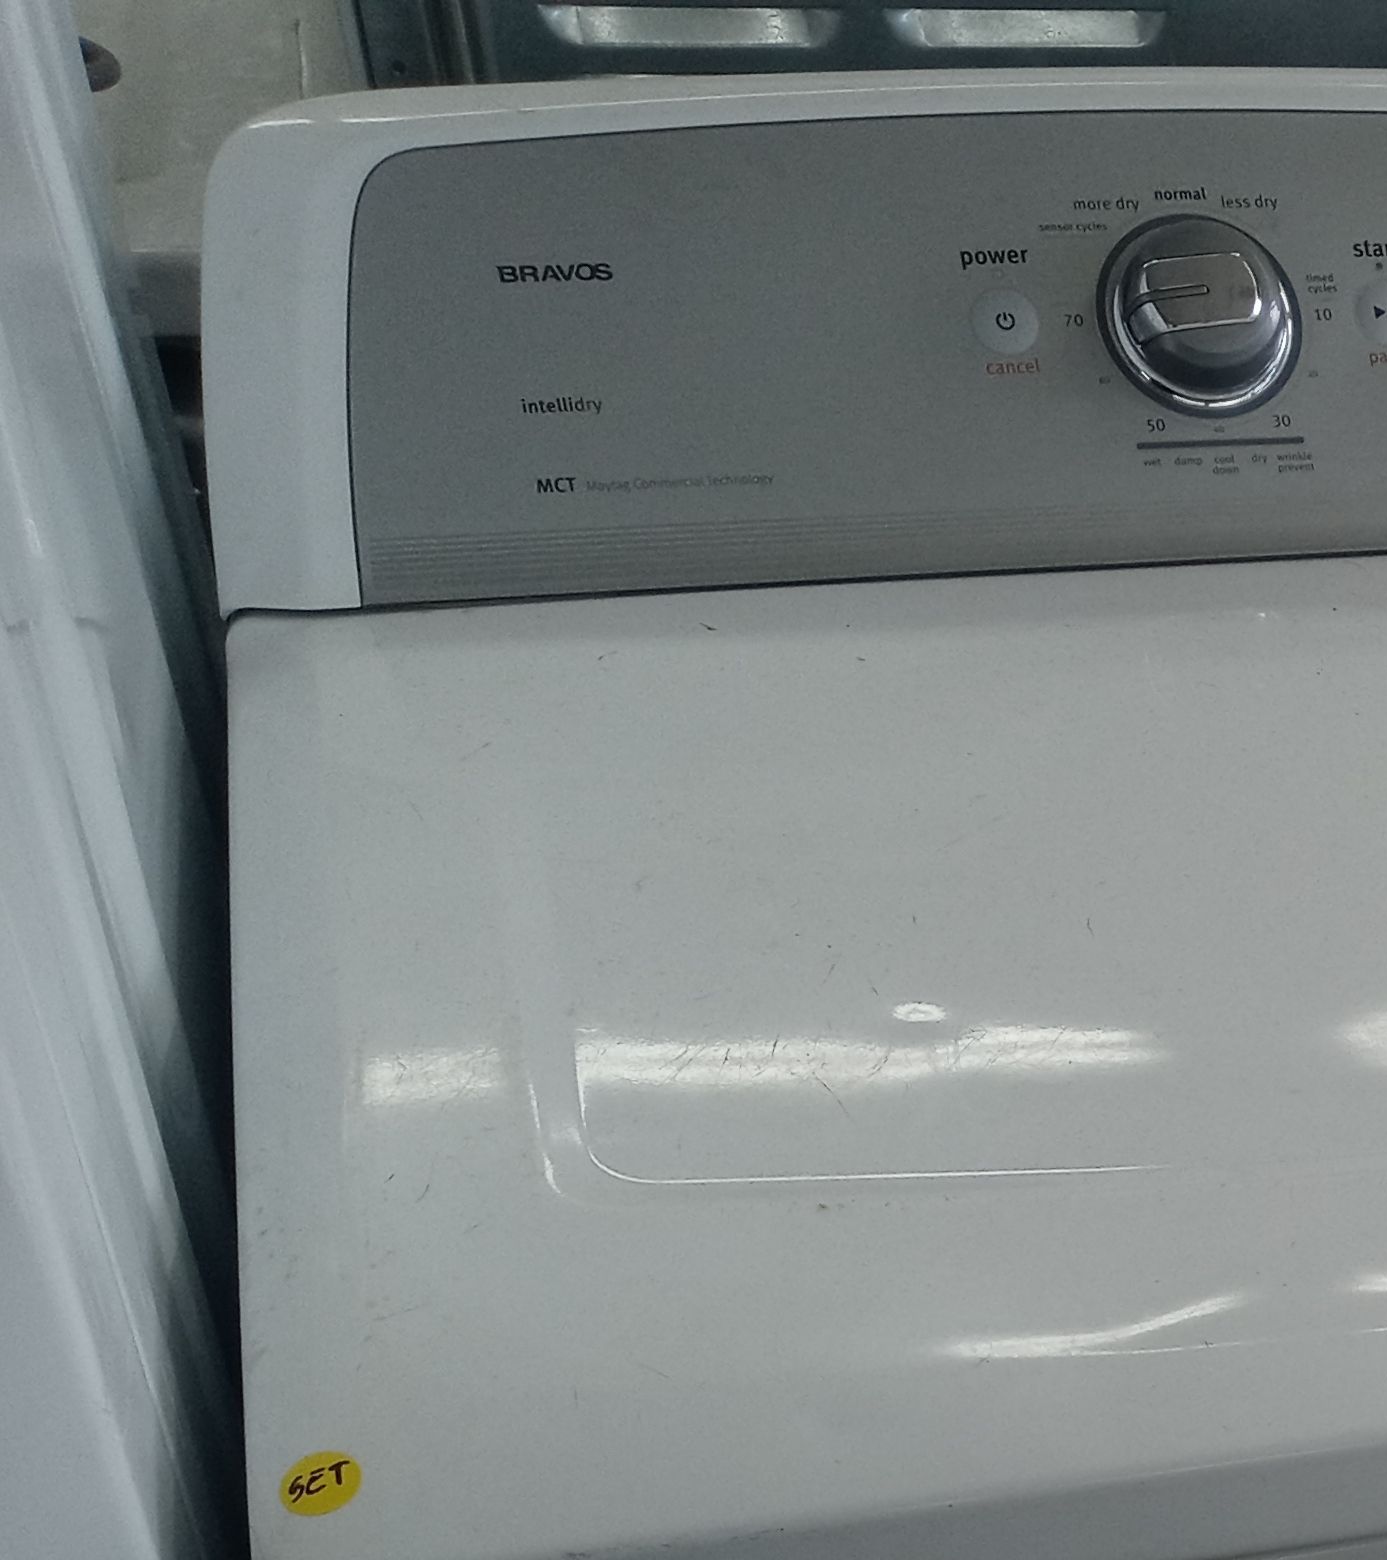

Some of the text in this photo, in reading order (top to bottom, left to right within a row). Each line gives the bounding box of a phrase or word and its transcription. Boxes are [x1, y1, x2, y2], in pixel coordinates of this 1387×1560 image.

[1153, 187, 1208, 202] normal
[1073, 196, 1140, 213] more dry
[1221, 195, 1279, 212] less dry
[1038, 221, 1108, 233] sensor cycles
[960, 246, 1029, 271] power
[496, 262, 614, 284] BRAVOS
[1305, 272, 1334, 284] timed
[1307, 282, 1338, 295] cycles
[1064, 313, 1084, 328] 70
[1314, 307, 1333, 322] 10
[984, 358, 1041, 376] cancel
[521, 396, 602, 416] intellidry
[1146, 418, 1167, 433] 50
[1272, 414, 1292, 428] 30
[1174, 456, 1203, 468] damp
[1213, 453, 1235, 465] cool
[1251, 453, 1268, 465] dry
[1276, 452, 1312, 463] wrinkle
[1278, 462, 1315, 473] prevent
[536, 477, 576, 494] MCT
[288, 1460, 350, 1504] SET
